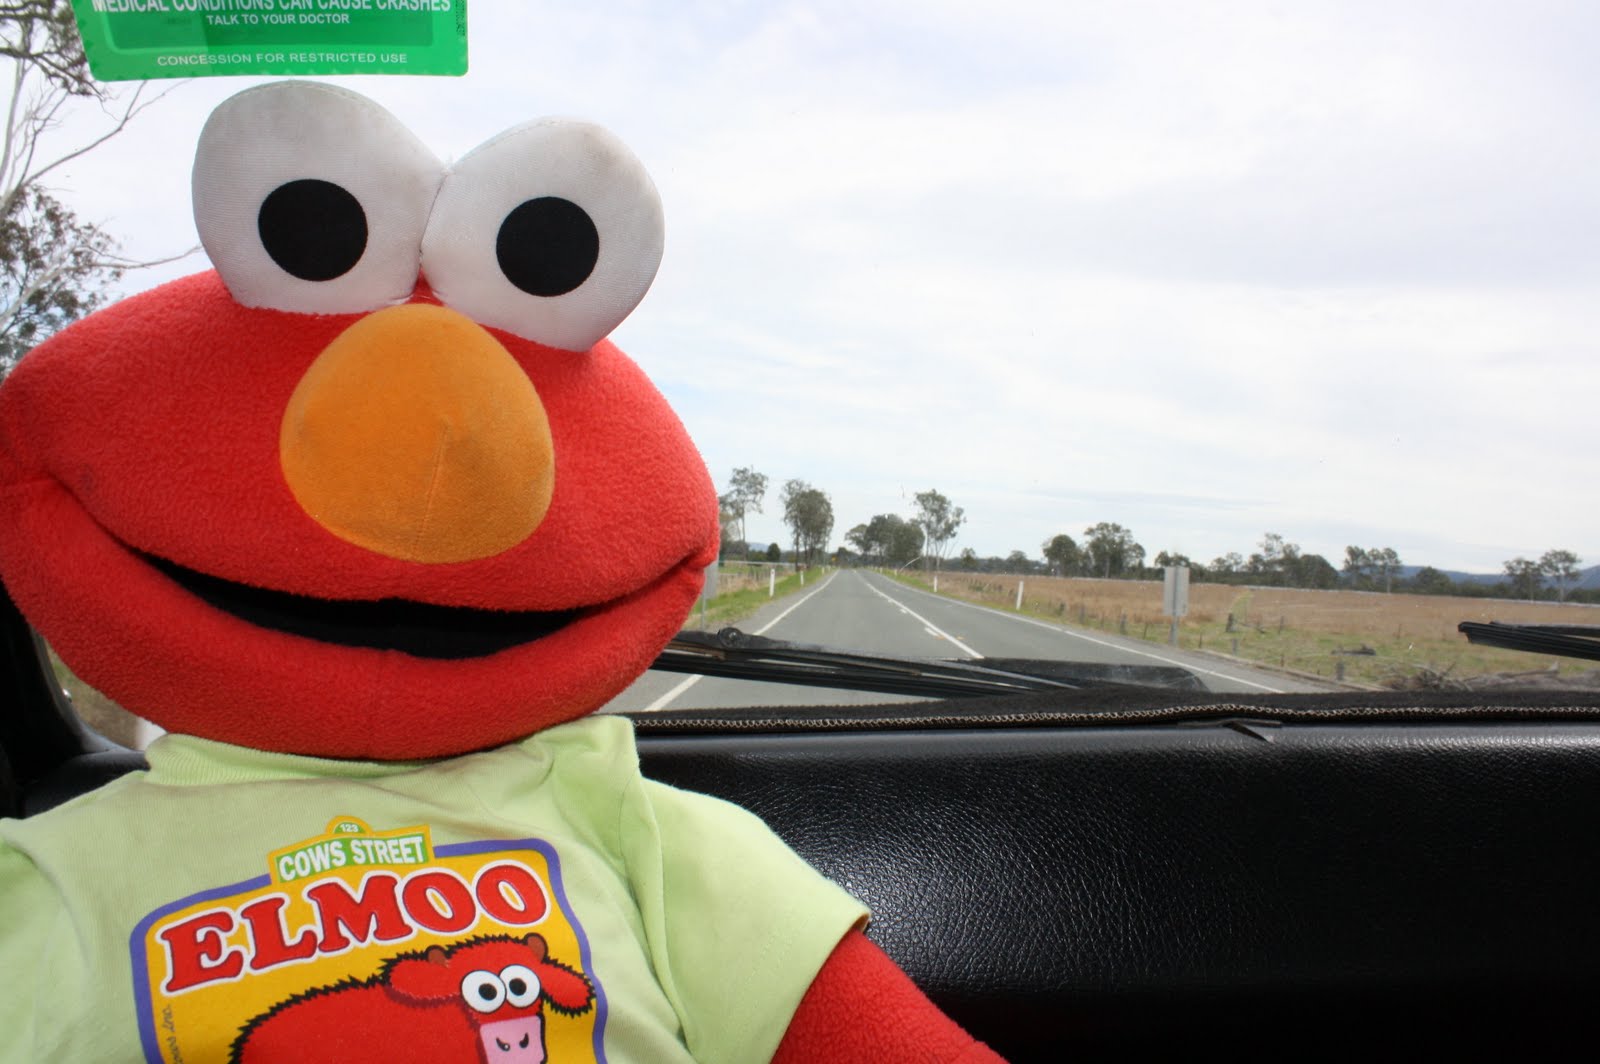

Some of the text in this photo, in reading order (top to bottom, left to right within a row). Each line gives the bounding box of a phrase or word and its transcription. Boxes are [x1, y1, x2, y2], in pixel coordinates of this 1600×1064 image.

[91, 0, 451, 12] MEDICAL CONDITIONS CAN CAUSE CRASHES
[207, 13, 350, 26] TALK TO YOUR DOCTOR
[157, 53, 408, 66] CONCESSION FOR RESTRICTED USE
[340, 823, 359, 833] 123
[279, 836, 425, 882] COWS STREET
[156, 859, 551, 996] ELMOO
